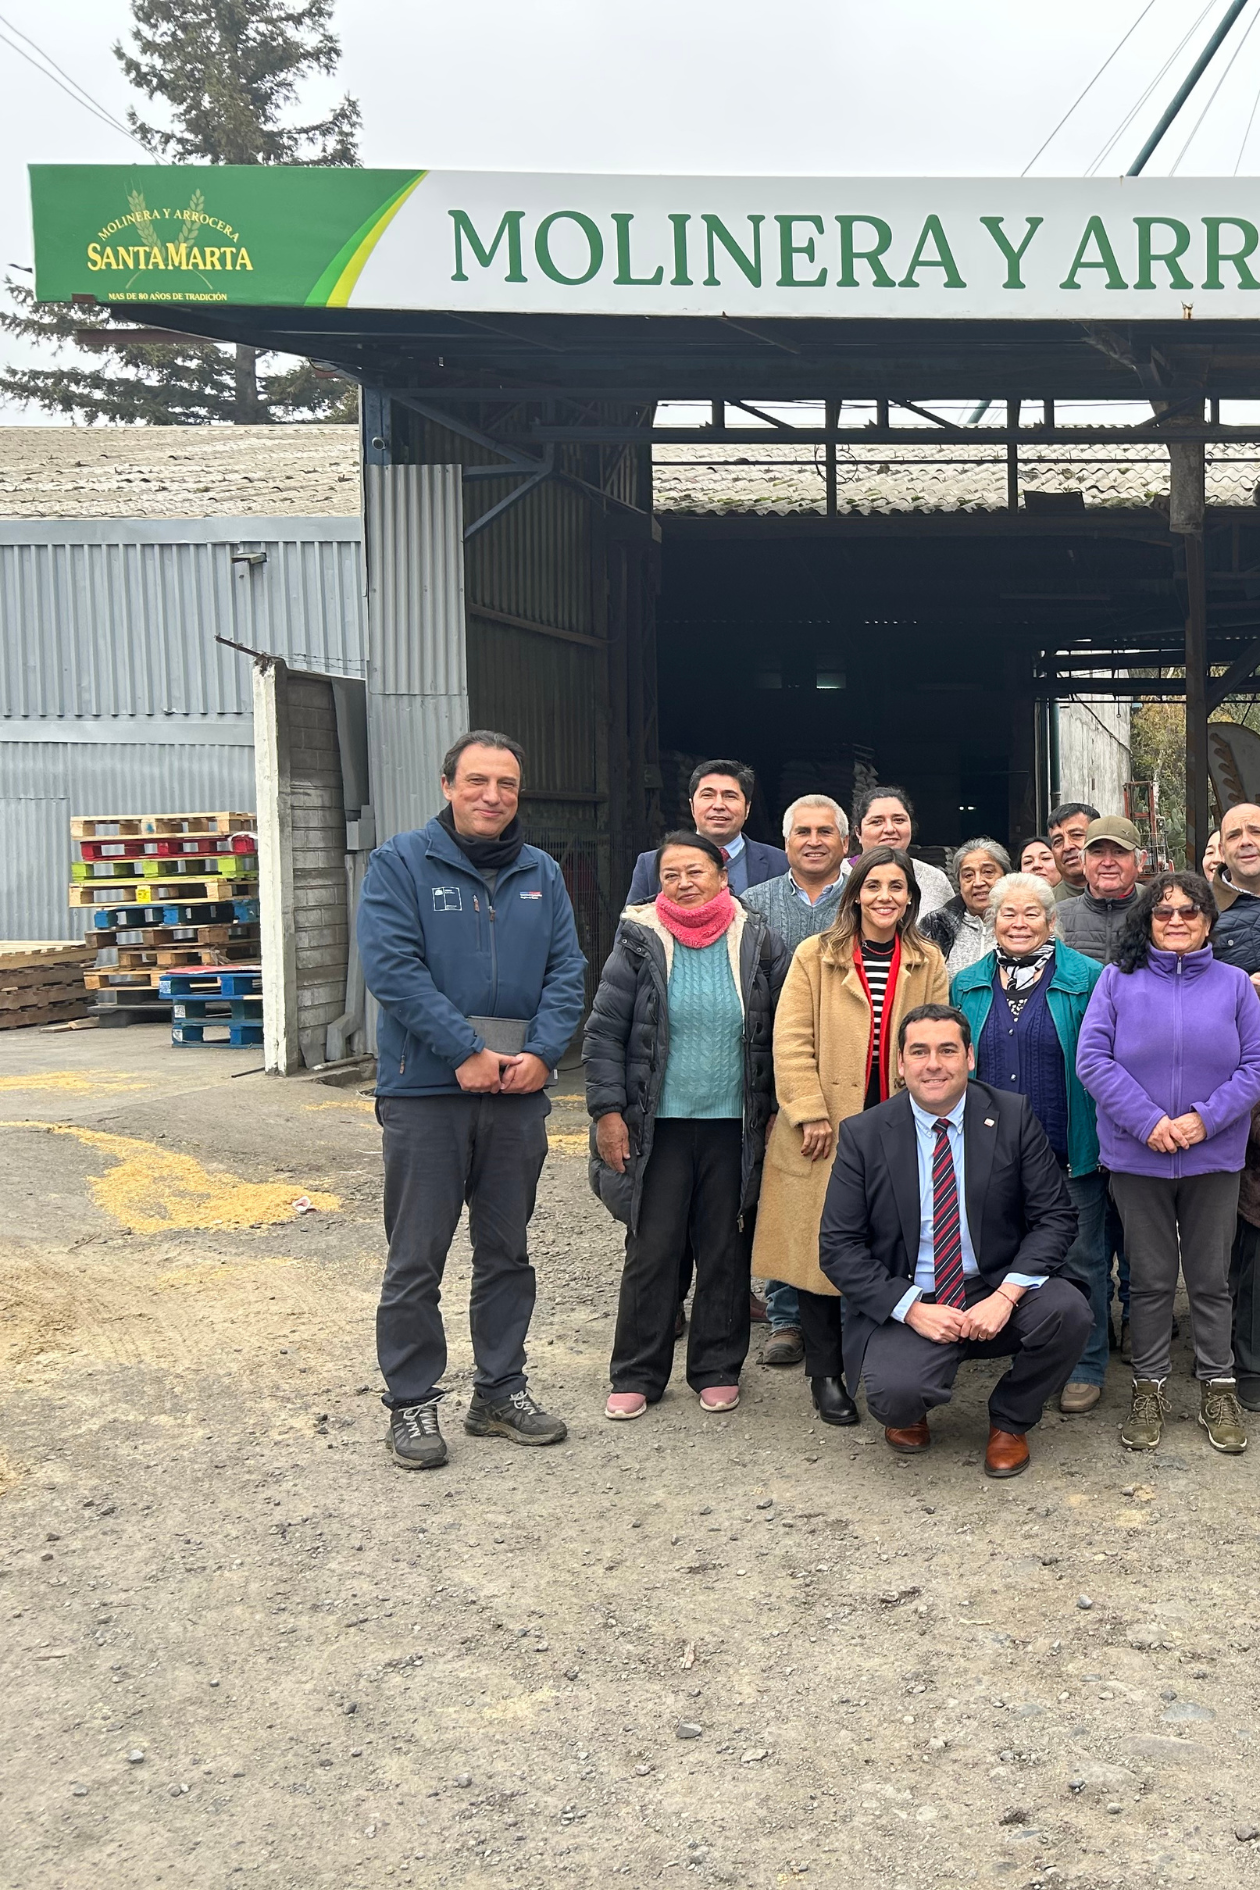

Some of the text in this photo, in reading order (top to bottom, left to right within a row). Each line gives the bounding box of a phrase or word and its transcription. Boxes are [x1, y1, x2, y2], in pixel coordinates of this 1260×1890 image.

[98, 208, 240, 243] MOLINERA Y ARROCERA
[448, 209, 968, 288] MOLINERA
[980, 216, 1044, 289] Y
[108, 291, 227, 301] MAS DE 80 AÑOS DE TRADICIÓN
